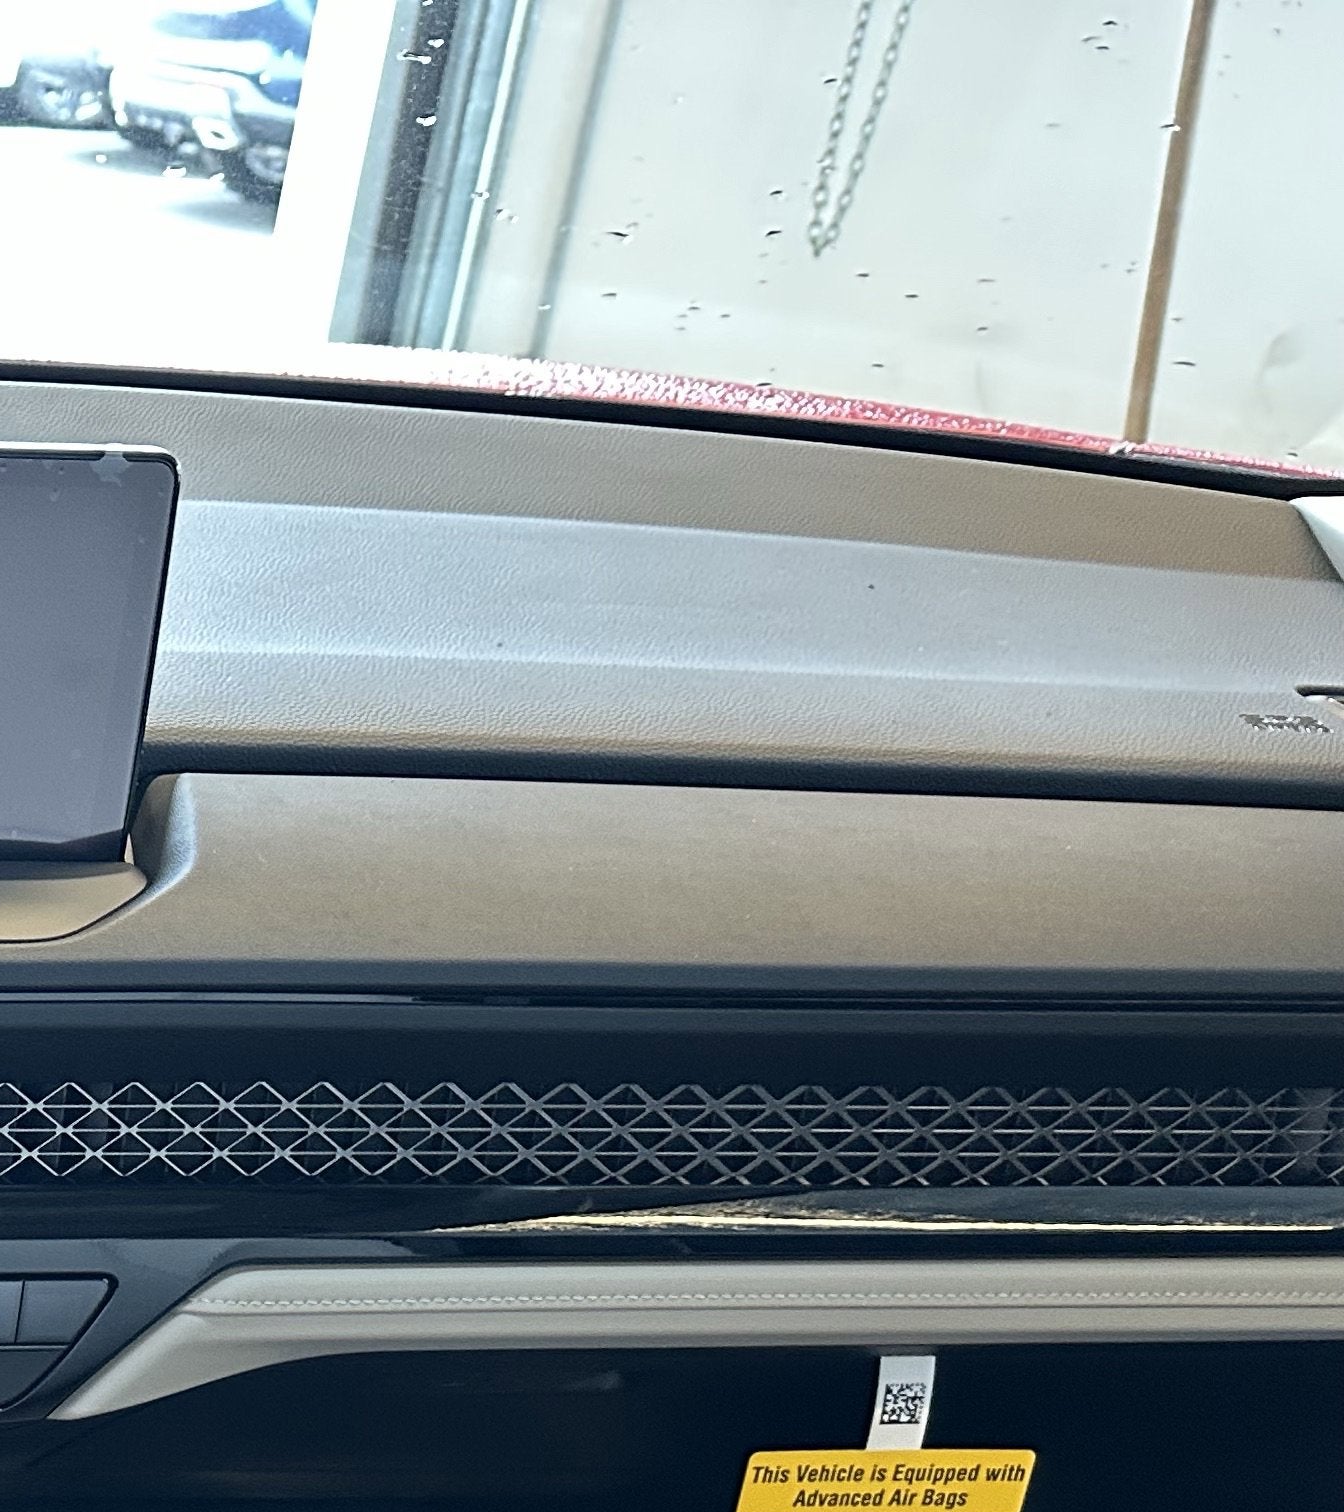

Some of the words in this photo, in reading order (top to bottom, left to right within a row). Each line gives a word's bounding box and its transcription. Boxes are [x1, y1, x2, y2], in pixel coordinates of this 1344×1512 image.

[752, 1466, 790, 1484] This
[796, 1464, 865, 1483] Vehicle
[870, 1464, 888, 1482] is
[892, 1463, 981, 1486] Equipped
[985, 1463, 1026, 1482] with
[792, 1488, 886, 1508] Advanced
[888, 1488, 918, 1507] Air
[921, 1488, 969, 1510] Bags
